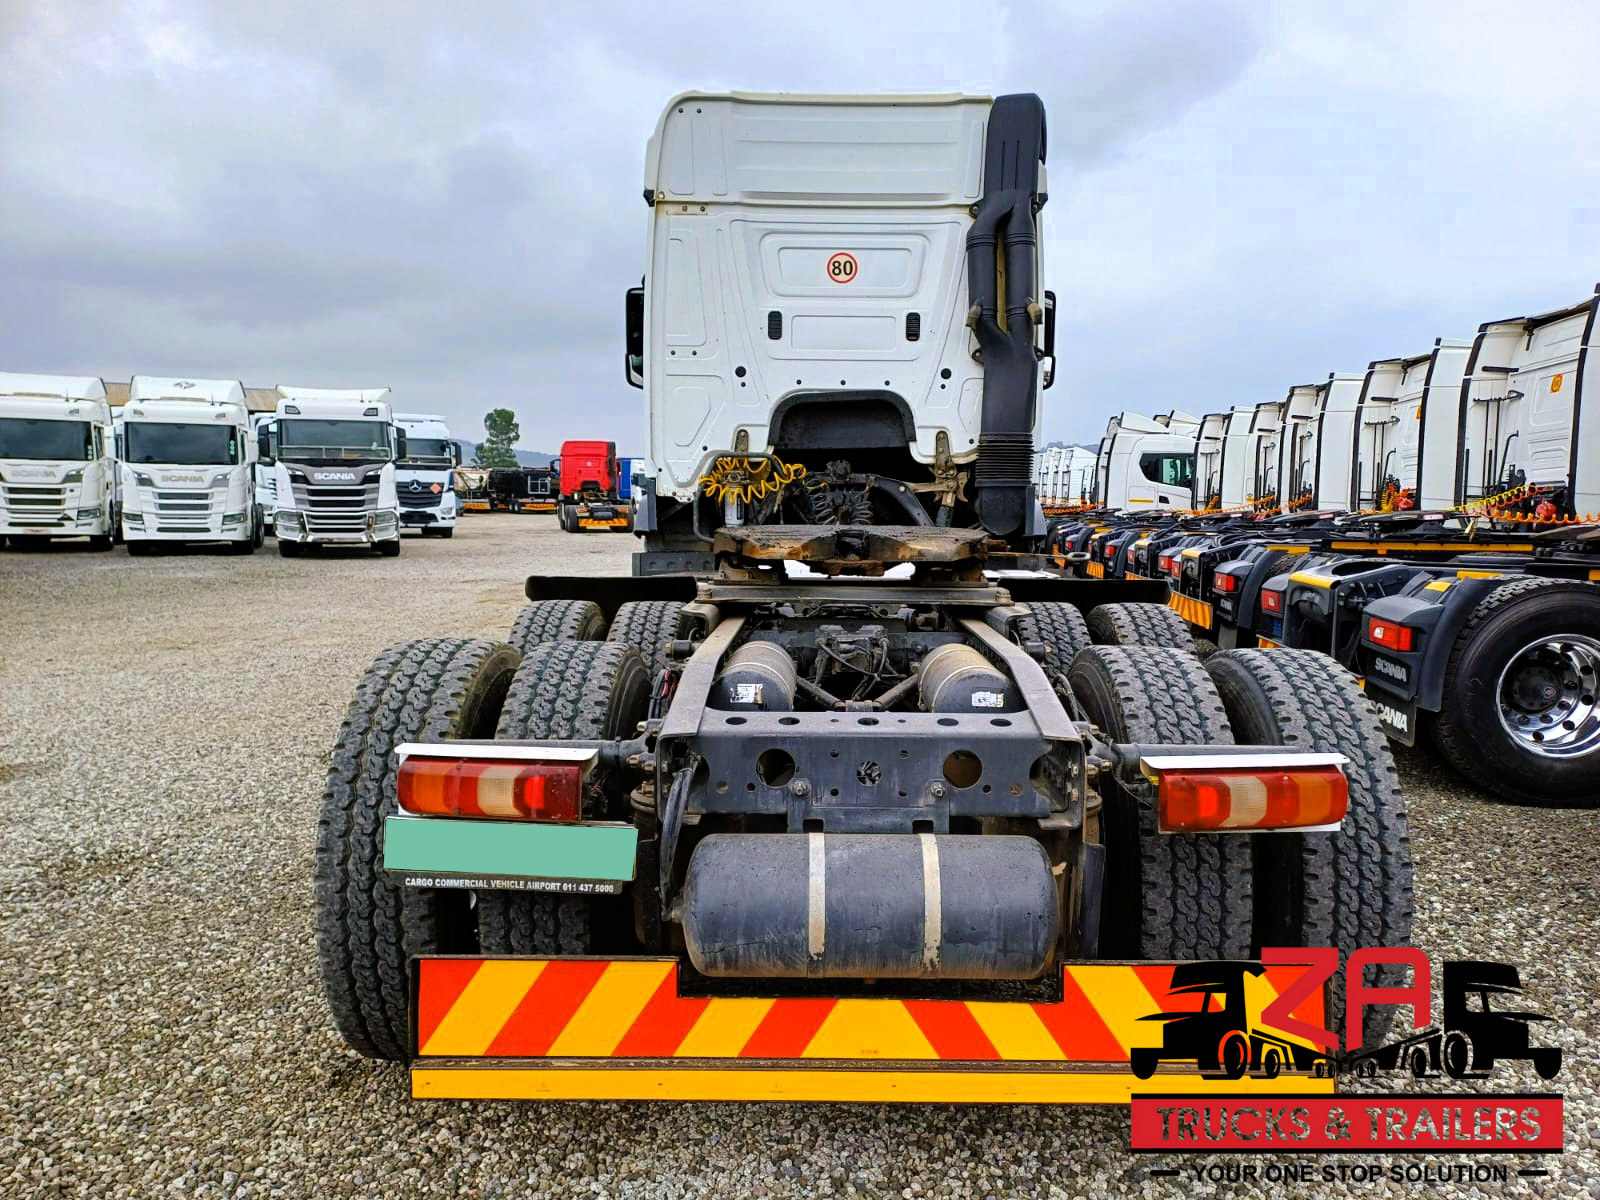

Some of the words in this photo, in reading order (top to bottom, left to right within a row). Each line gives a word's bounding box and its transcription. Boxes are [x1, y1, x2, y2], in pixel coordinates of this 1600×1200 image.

[832, 260, 854, 276] 80
[160, 474, 205, 482] SCANIA
[313, 472, 356, 481] SCANIA
[1374, 657, 1407, 682] SCANIA
[405, 877, 433, 887] CARGO
[434, 878, 489, 888] COMMERCIAL
[490, 880, 525, 889] VEHICLE
[526, 881, 561, 891] AIRPORT
[562, 882, 577, 891] 011
[578, 883, 594, 892] 437
